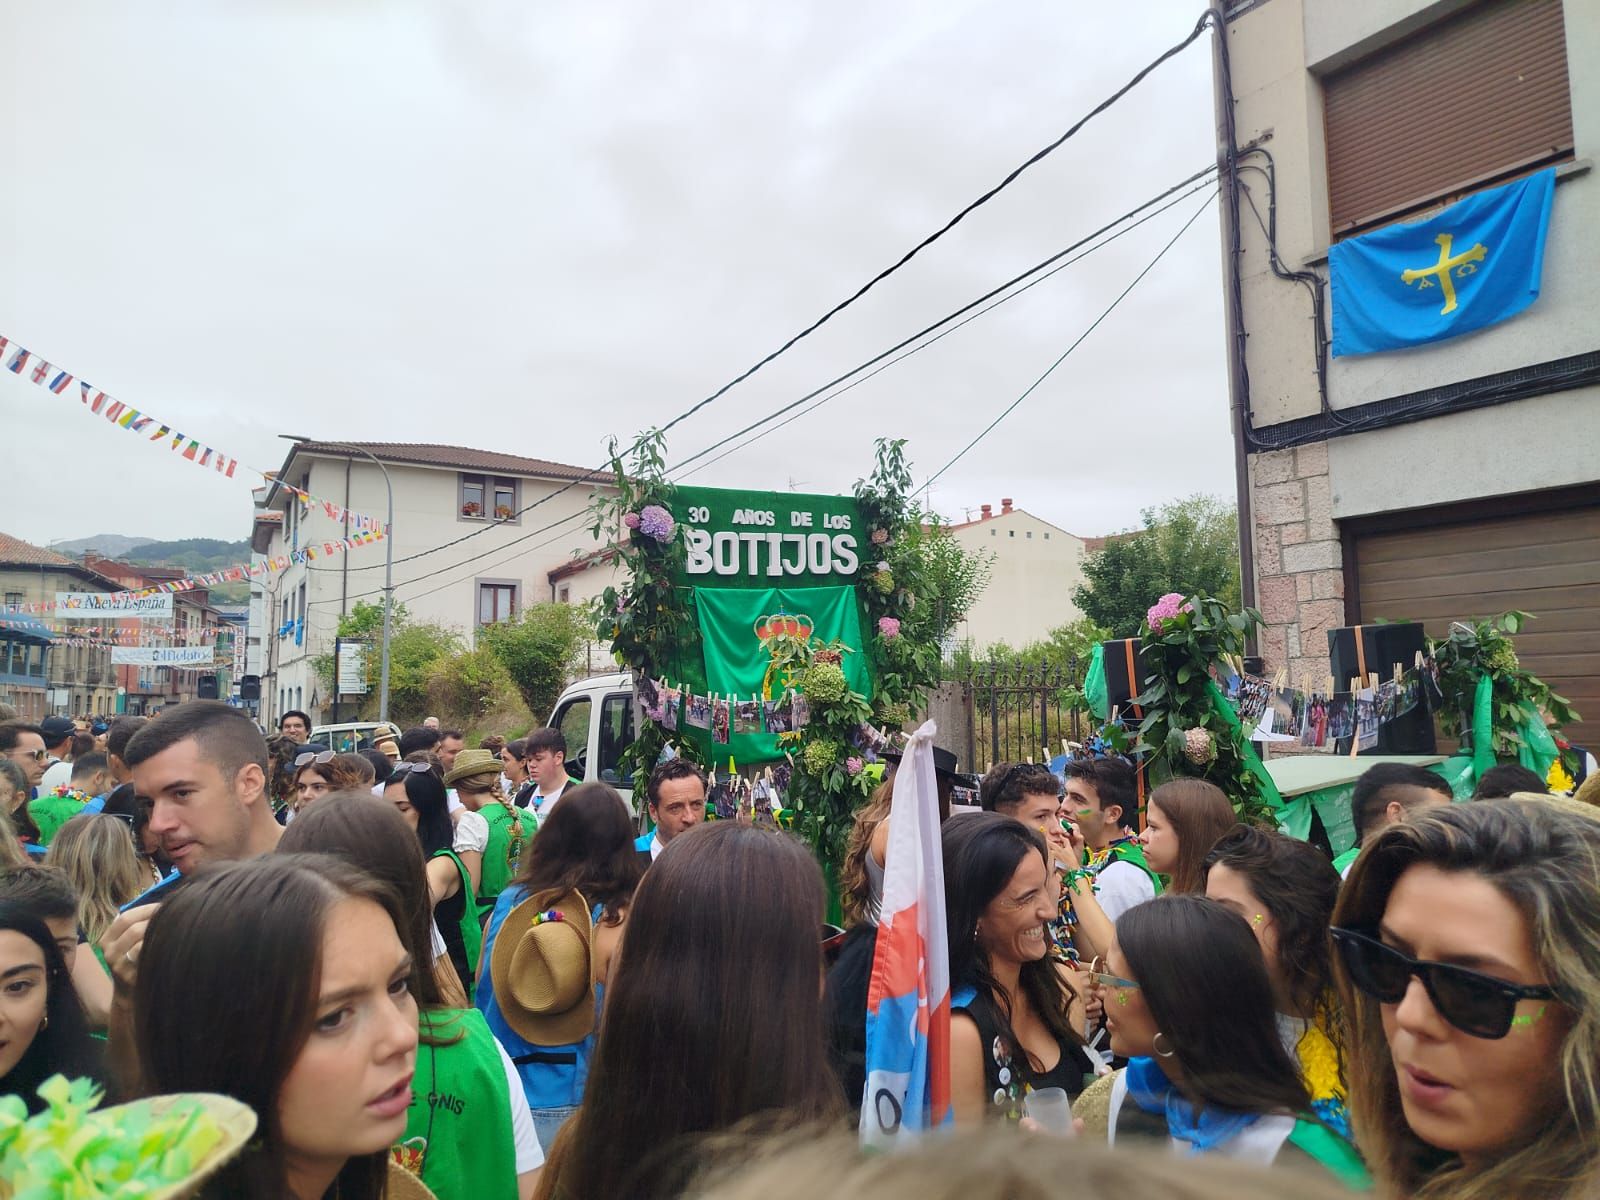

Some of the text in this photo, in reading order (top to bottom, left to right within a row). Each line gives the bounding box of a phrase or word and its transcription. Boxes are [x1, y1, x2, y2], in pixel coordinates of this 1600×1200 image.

[688, 506, 852, 530] 30 AÑOS DE LOS
[686, 529, 859, 577] BOTIJOS
[84, 594, 121, 610] Nueva
[124, 594, 166, 611] España
[235, 626, 244, 683] HOSTAL
